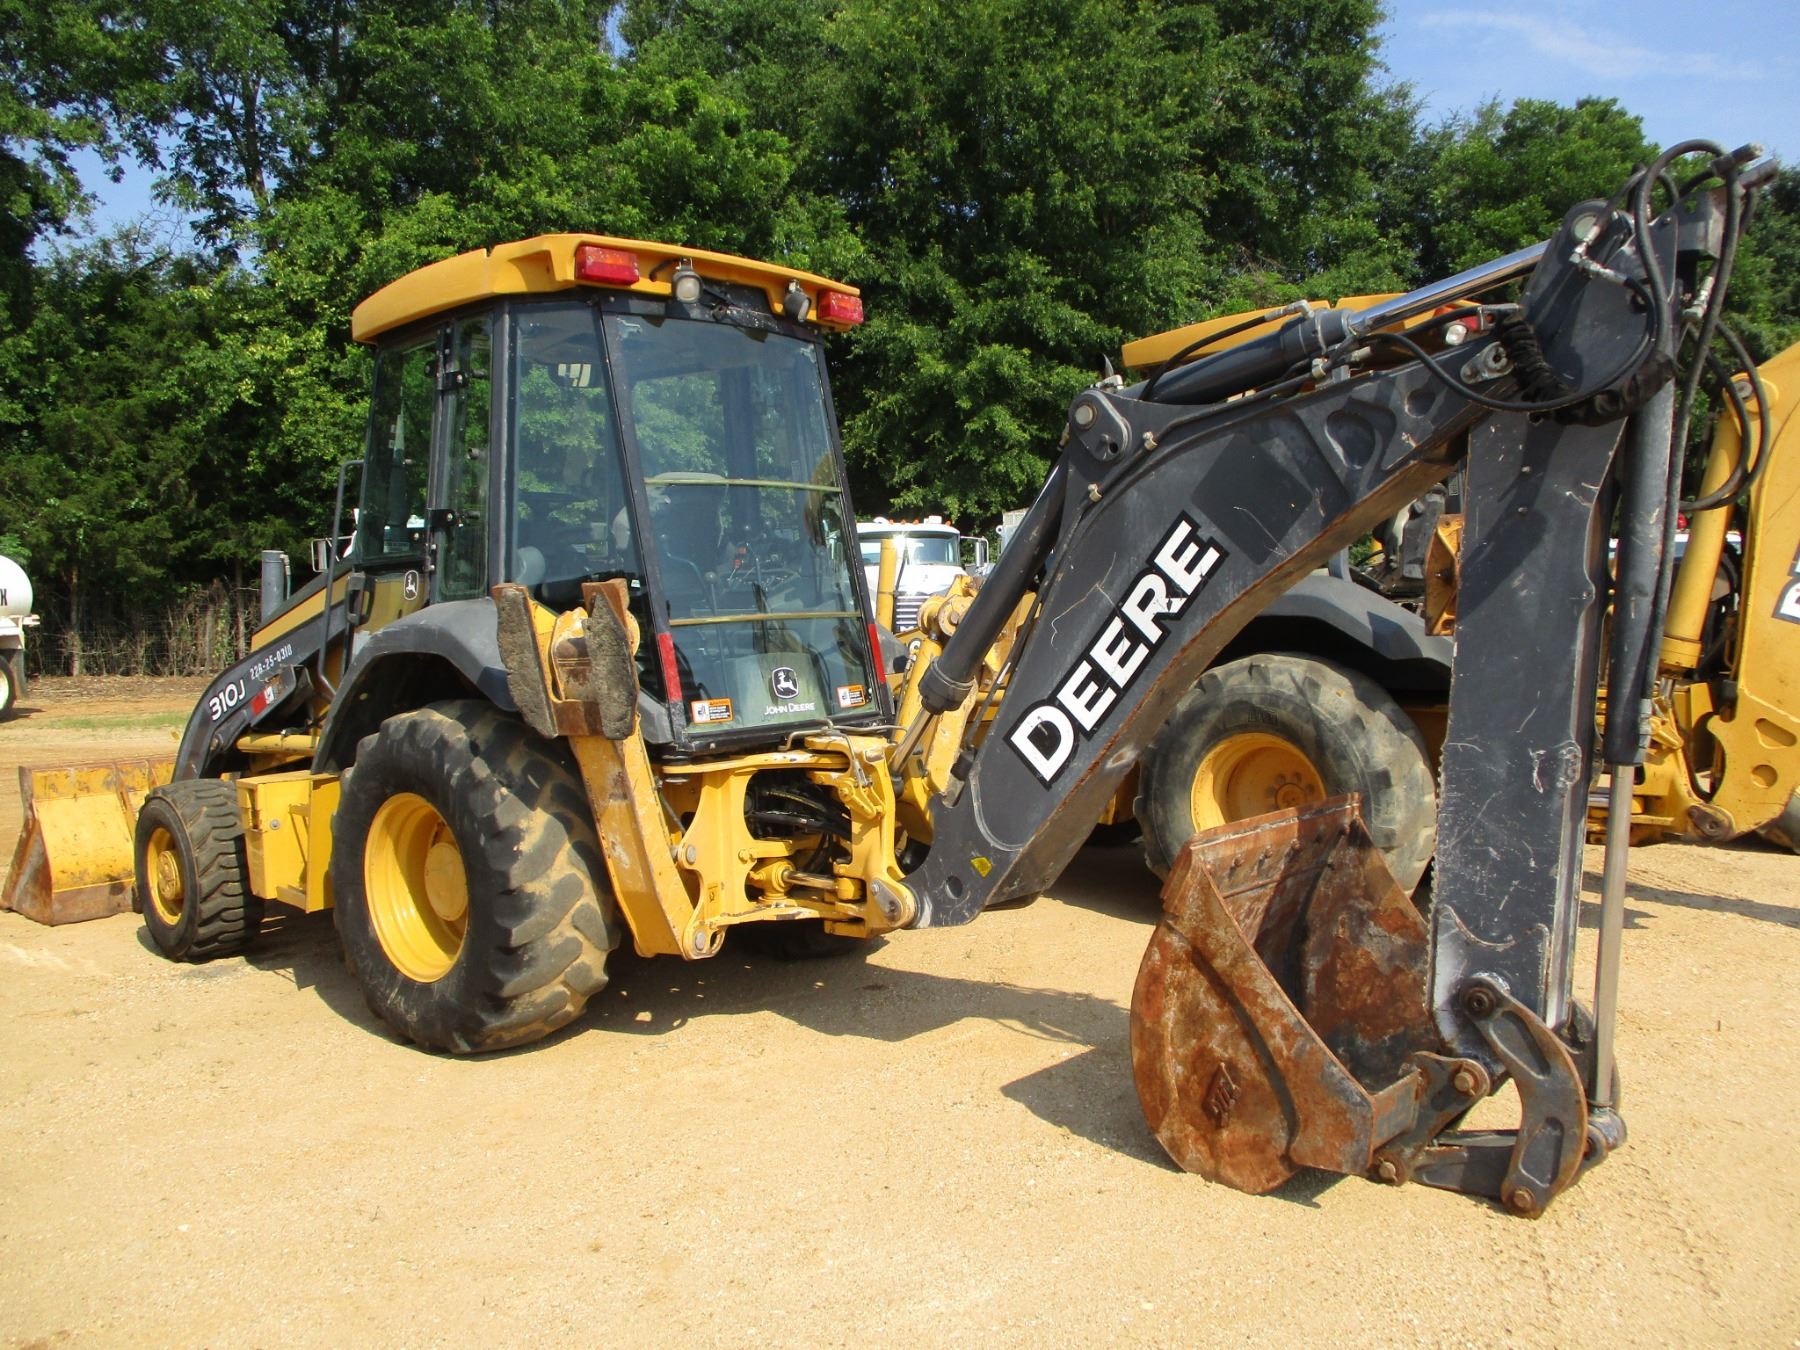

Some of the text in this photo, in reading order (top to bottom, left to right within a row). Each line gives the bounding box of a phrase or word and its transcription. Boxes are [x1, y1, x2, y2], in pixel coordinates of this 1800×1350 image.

[1009, 519, 1221, 783] DEERE
[208, 679, 246, 721] 310J
[764, 702, 816, 716] JOHN DEERE
